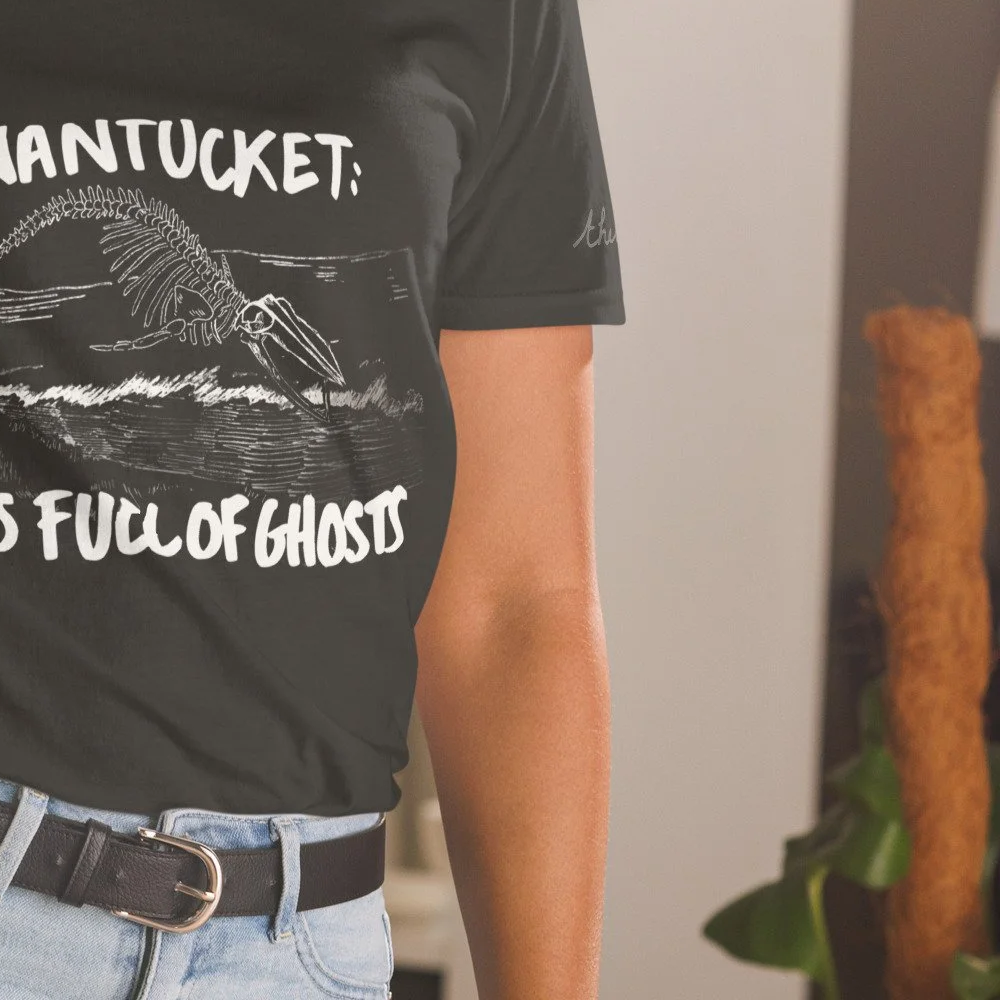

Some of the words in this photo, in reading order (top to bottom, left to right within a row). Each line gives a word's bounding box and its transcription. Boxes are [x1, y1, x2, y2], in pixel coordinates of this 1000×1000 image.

[32, 489, 183, 562] FULL
[185, 493, 250, 563] OF
[254, 484, 408, 568] GHOSTS
